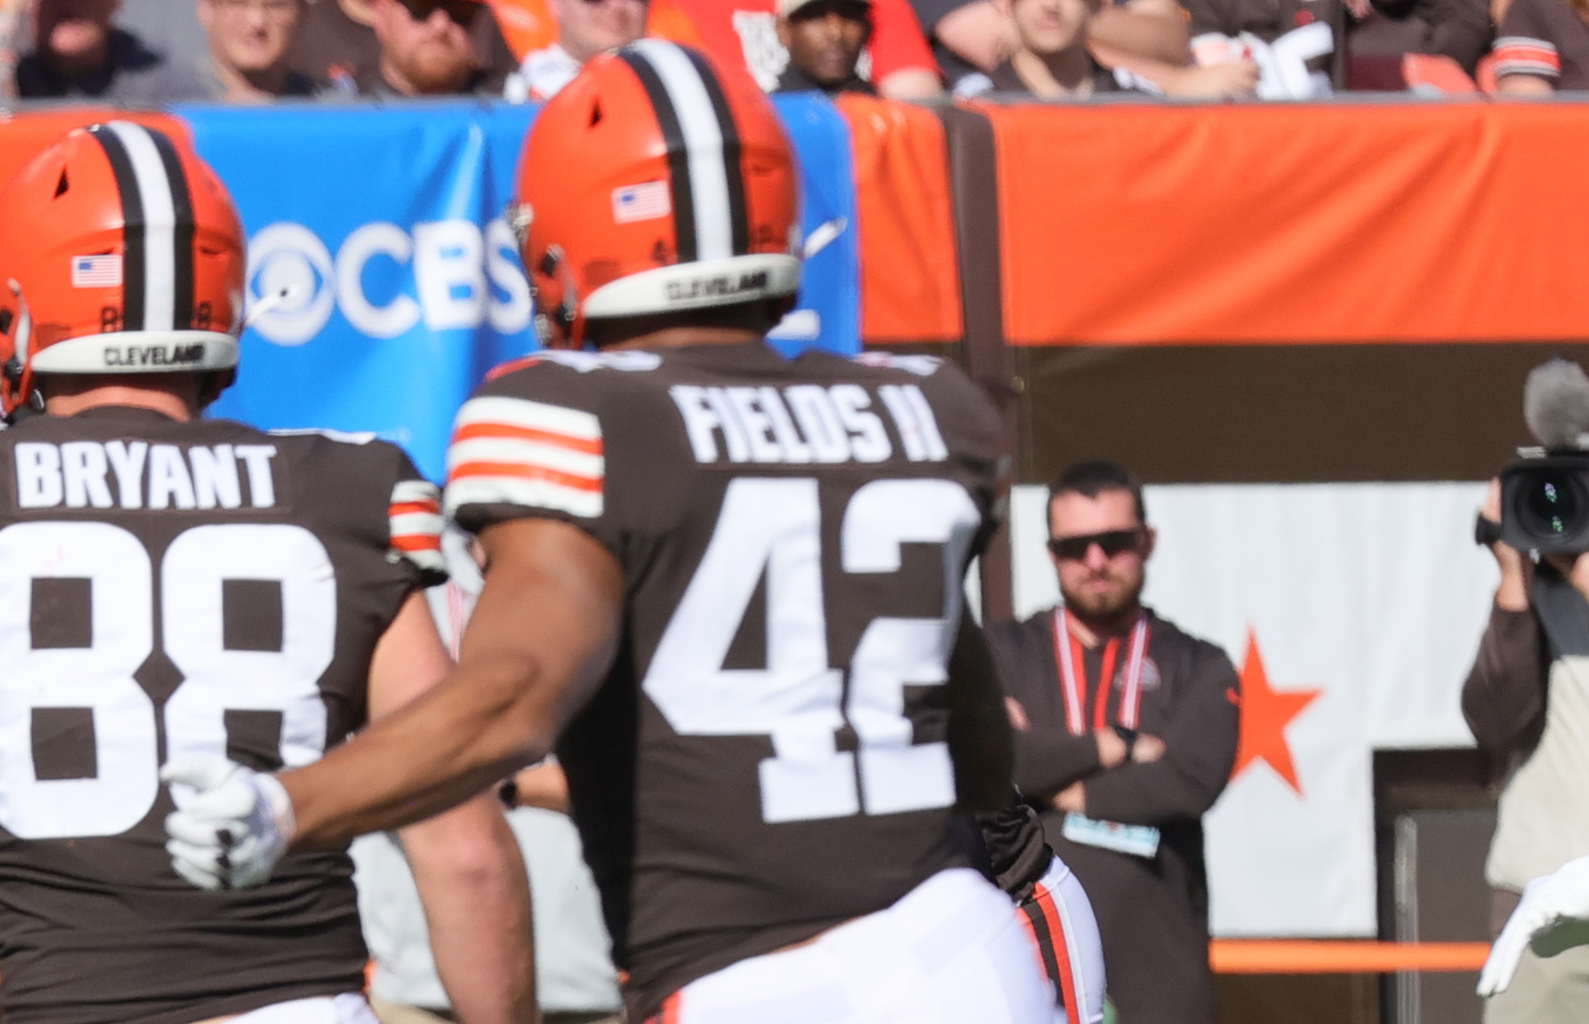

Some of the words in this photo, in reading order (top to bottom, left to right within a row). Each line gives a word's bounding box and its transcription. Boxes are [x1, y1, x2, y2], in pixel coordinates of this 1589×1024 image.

[335, 219, 533, 340] CBS
[103, 340, 206, 368] CLEVELAND
[668, 383, 893, 464] FIELDS
[877, 384, 949, 462] II
[14, 440, 277, 511] BRYANT
[641, 476, 983, 824] 42
